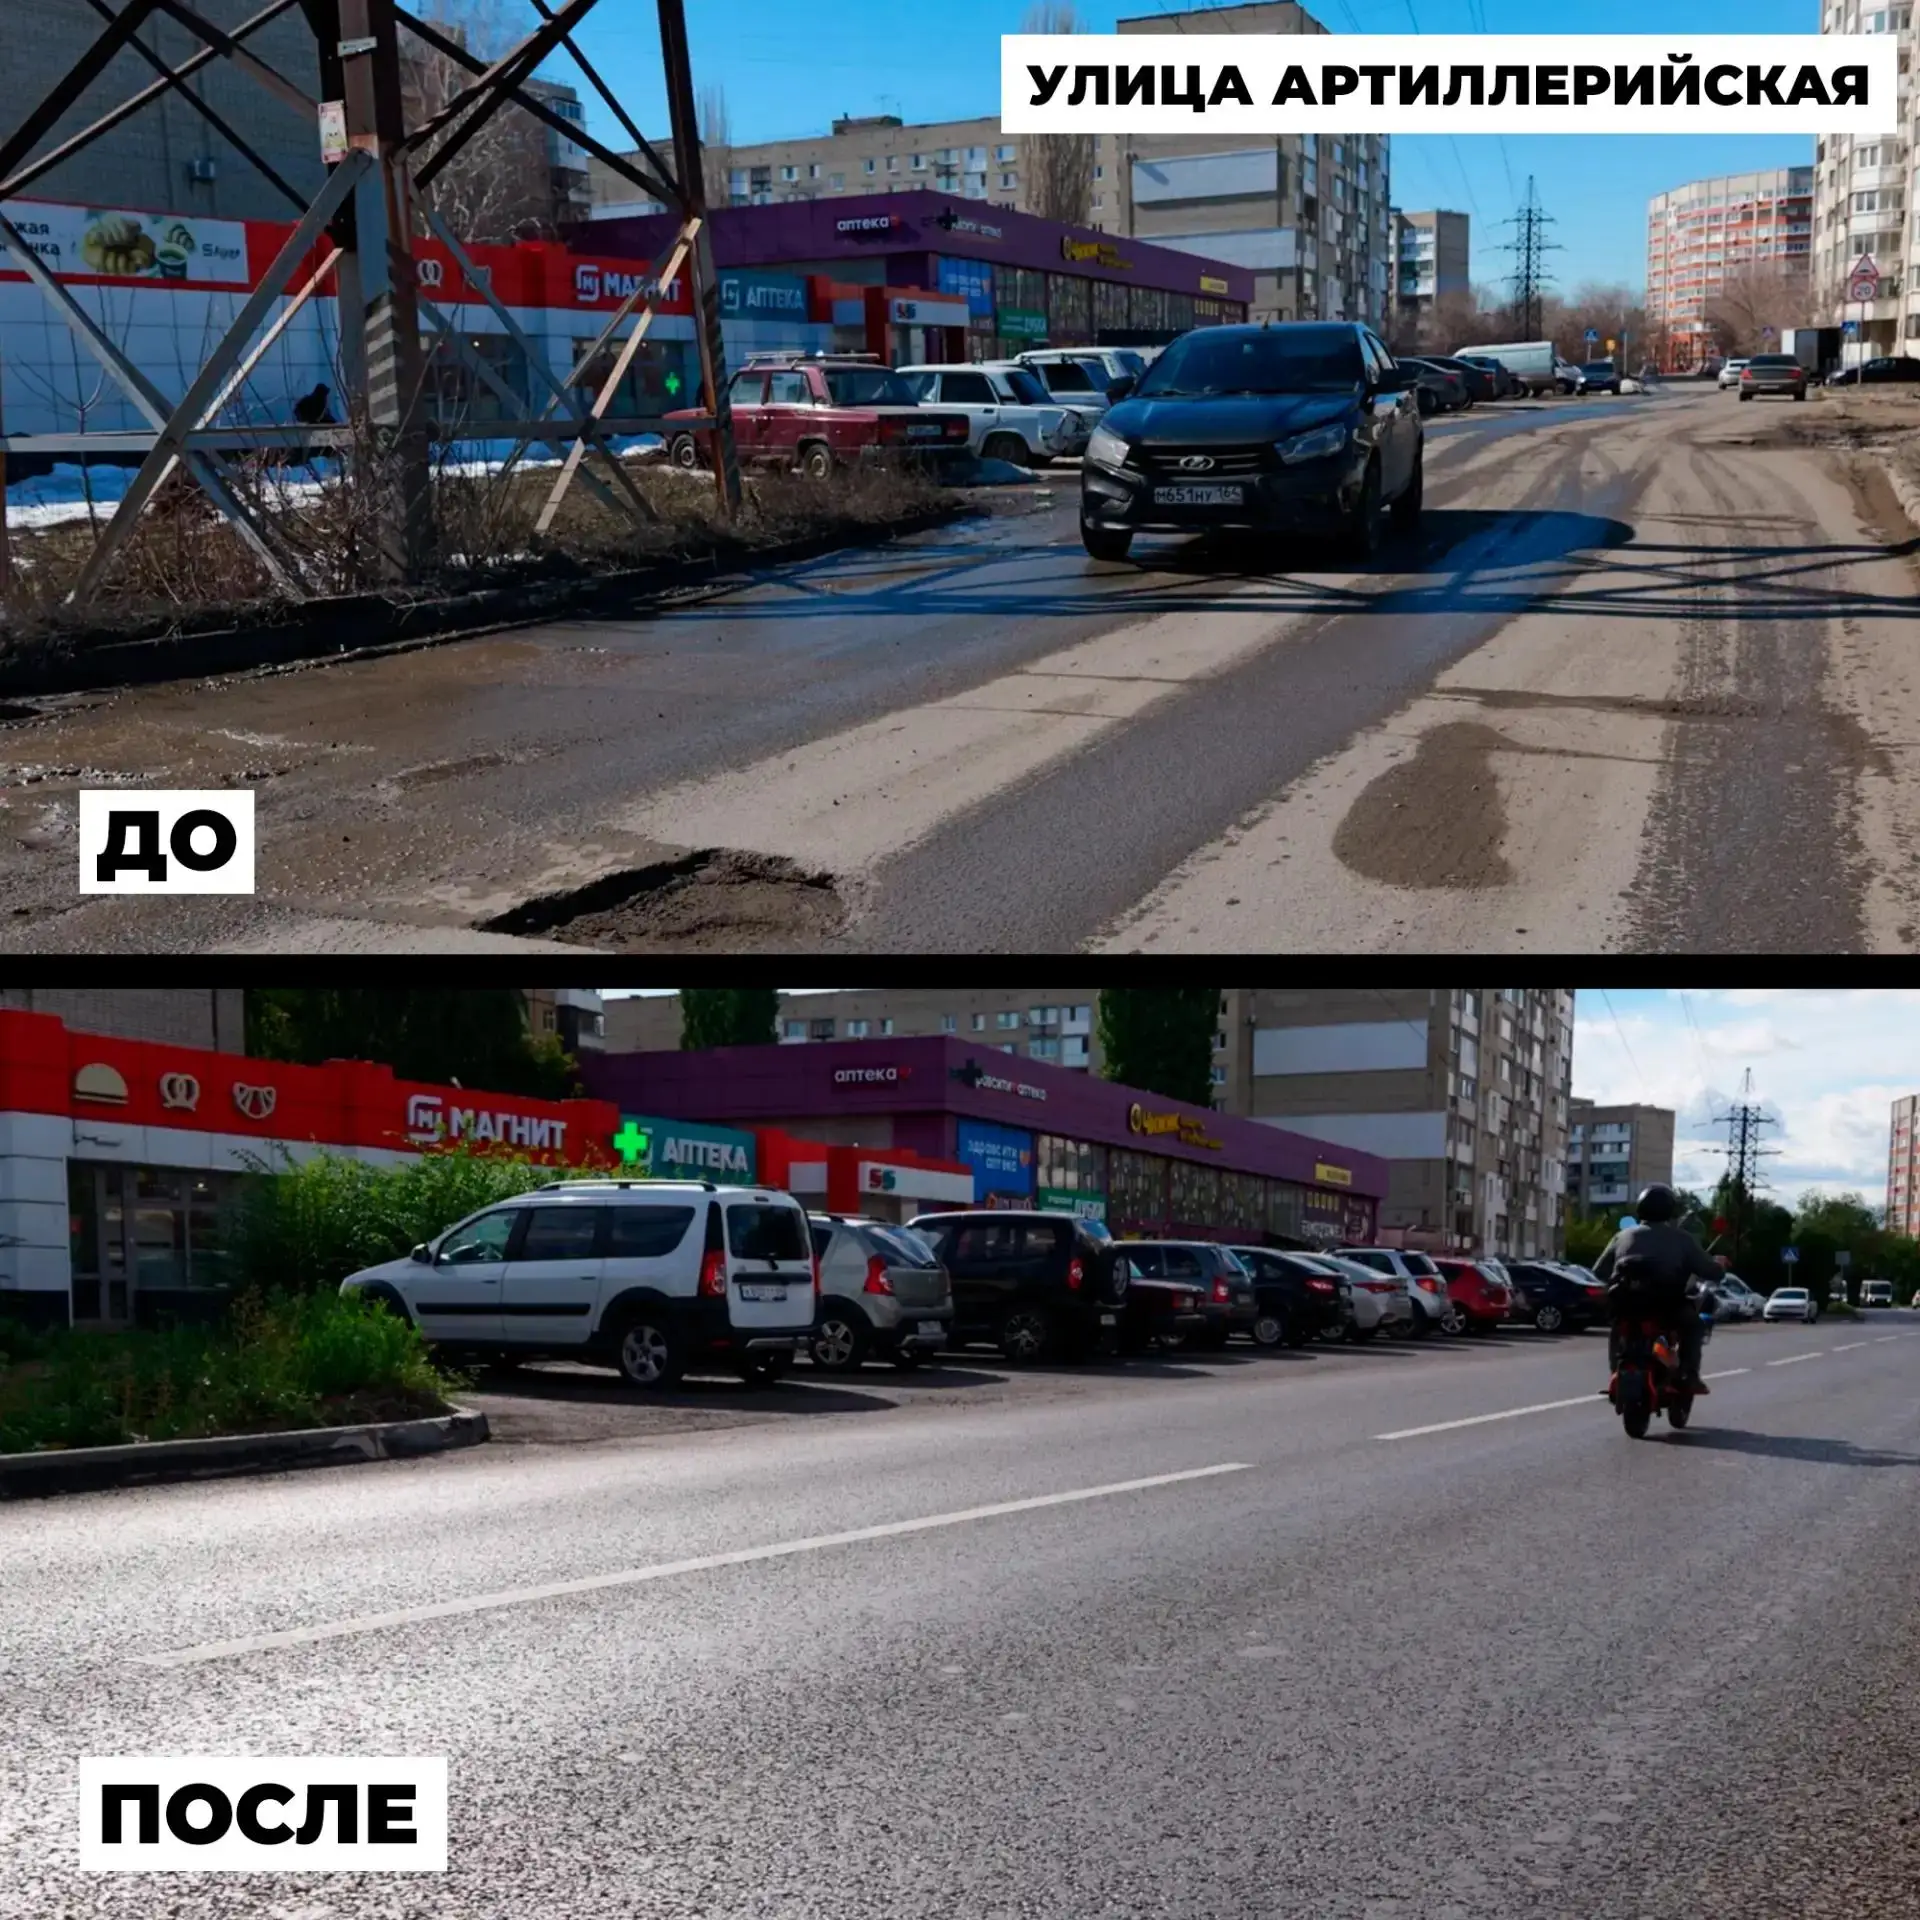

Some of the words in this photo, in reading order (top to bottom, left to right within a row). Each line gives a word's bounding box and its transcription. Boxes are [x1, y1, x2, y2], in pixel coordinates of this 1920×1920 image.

[836, 216, 889, 231] аптека
[746, 287, 805, 310] АПТЕКА
[834, 1067, 898, 1083] аптека
[450, 1106, 568, 1149] МАГНИТ
[661, 1137, 748, 1172] АПТЕКА
